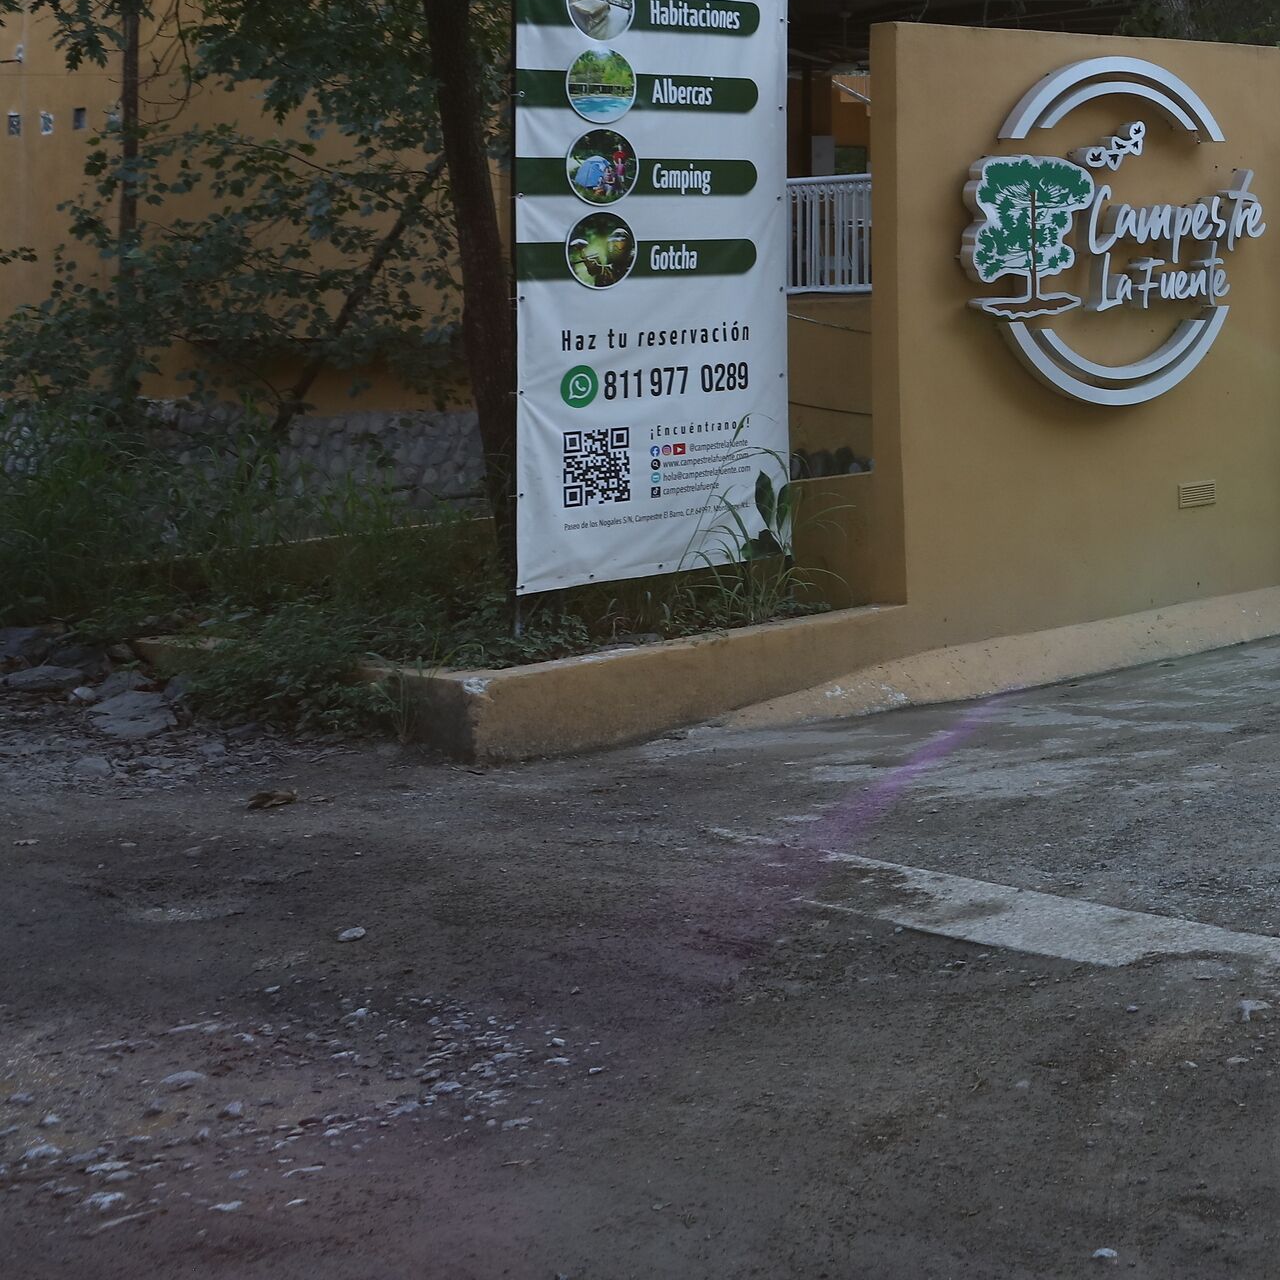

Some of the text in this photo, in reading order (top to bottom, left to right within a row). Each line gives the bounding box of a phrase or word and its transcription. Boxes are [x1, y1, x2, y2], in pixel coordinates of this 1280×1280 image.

[650, 0, 740, 29] Habitaciones
[652, 78, 713, 106] Albercas
[652, 163, 712, 195] Camping
[1088, 169, 1266, 264] Campestre
[650, 243, 698, 271] Gotcha
[1096, 241, 1231, 311] La Fuente
[561, 320, 750, 351] Haz tu reservación
[604, 361, 749, 401] 811 977 0289
[662, 465, 751, 481] hola@campestrelafuente.com
[662, 482, 720, 495] campestrelafuente
[564, 523, 580, 531] Paseo
[581, 521, 589, 529] de
